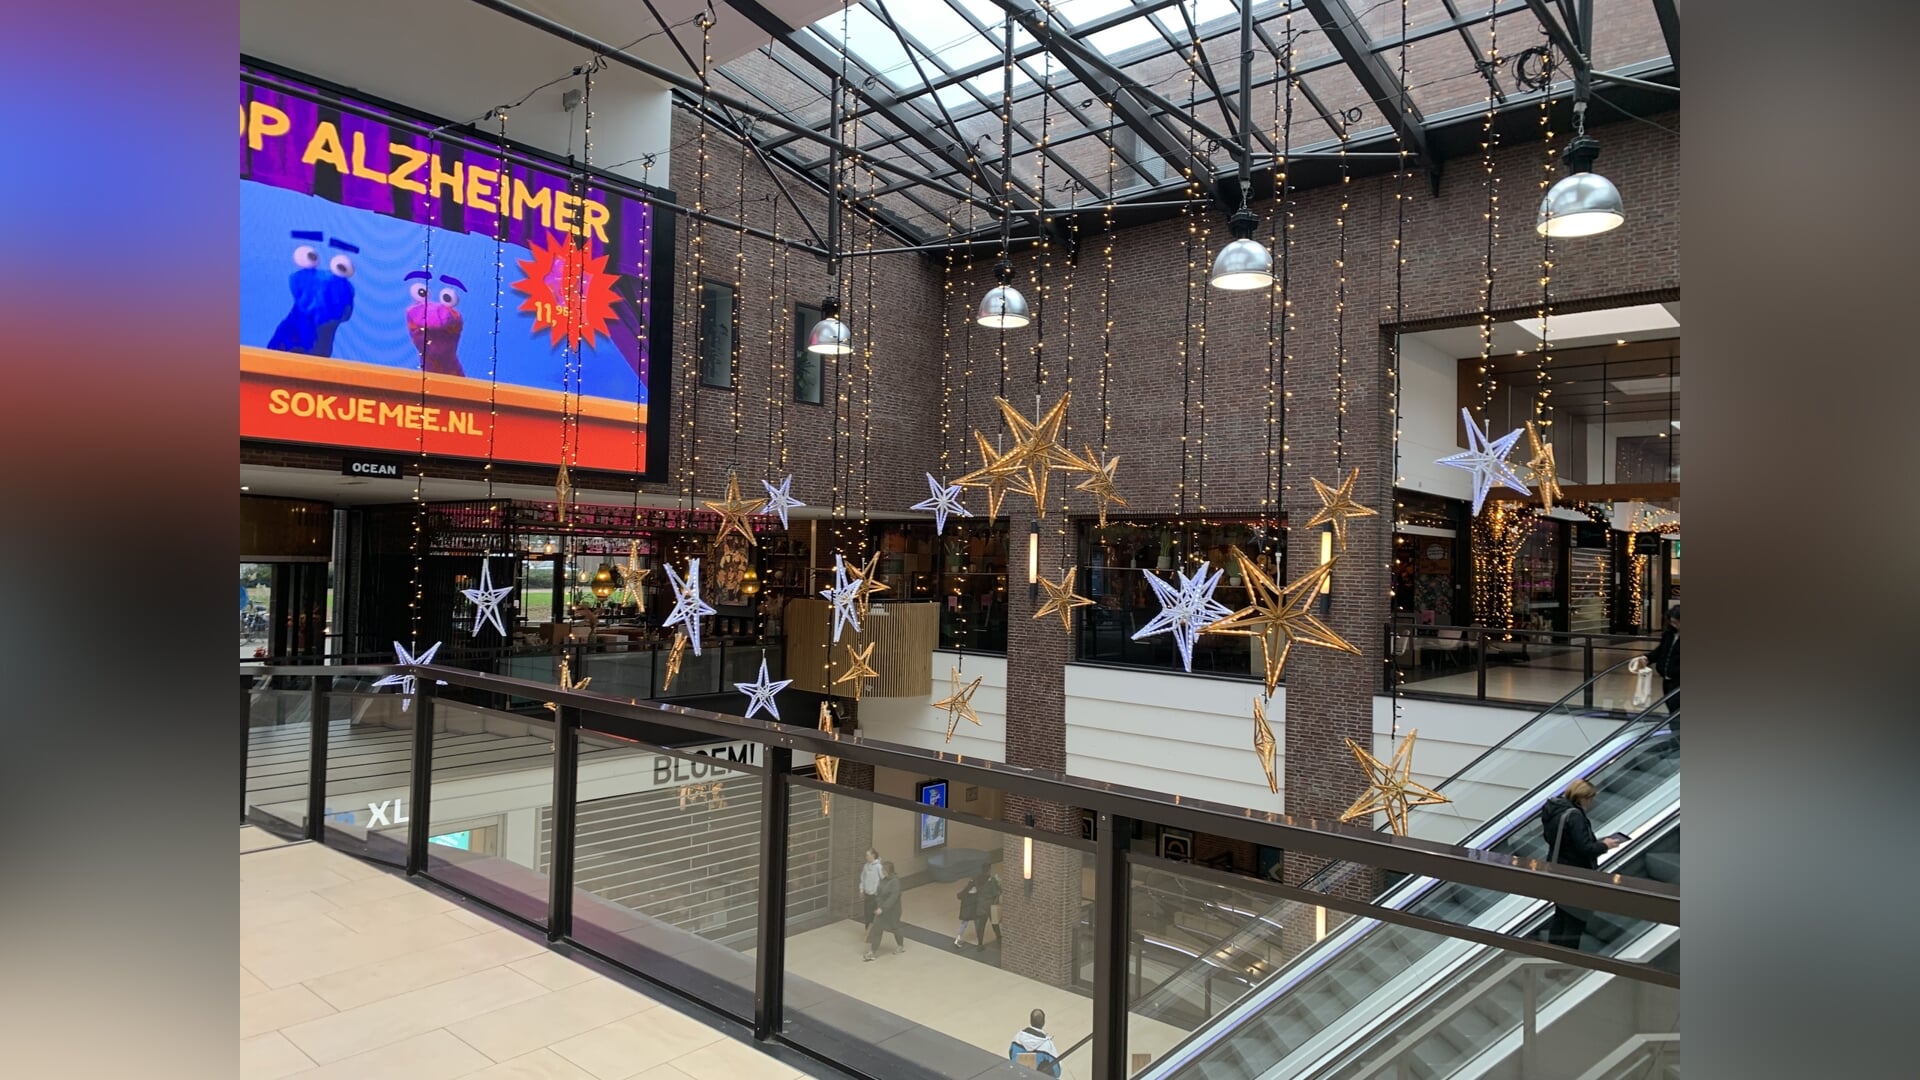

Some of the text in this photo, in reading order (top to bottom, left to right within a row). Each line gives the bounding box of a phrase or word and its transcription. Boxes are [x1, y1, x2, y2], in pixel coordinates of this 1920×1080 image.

[240, 101, 611, 243] P ALZHEIMER
[268, 388, 484, 436] SOKJEMEE.NL
[352, 462, 397, 475] OCEAN
[366, 798, 410, 829] XL
